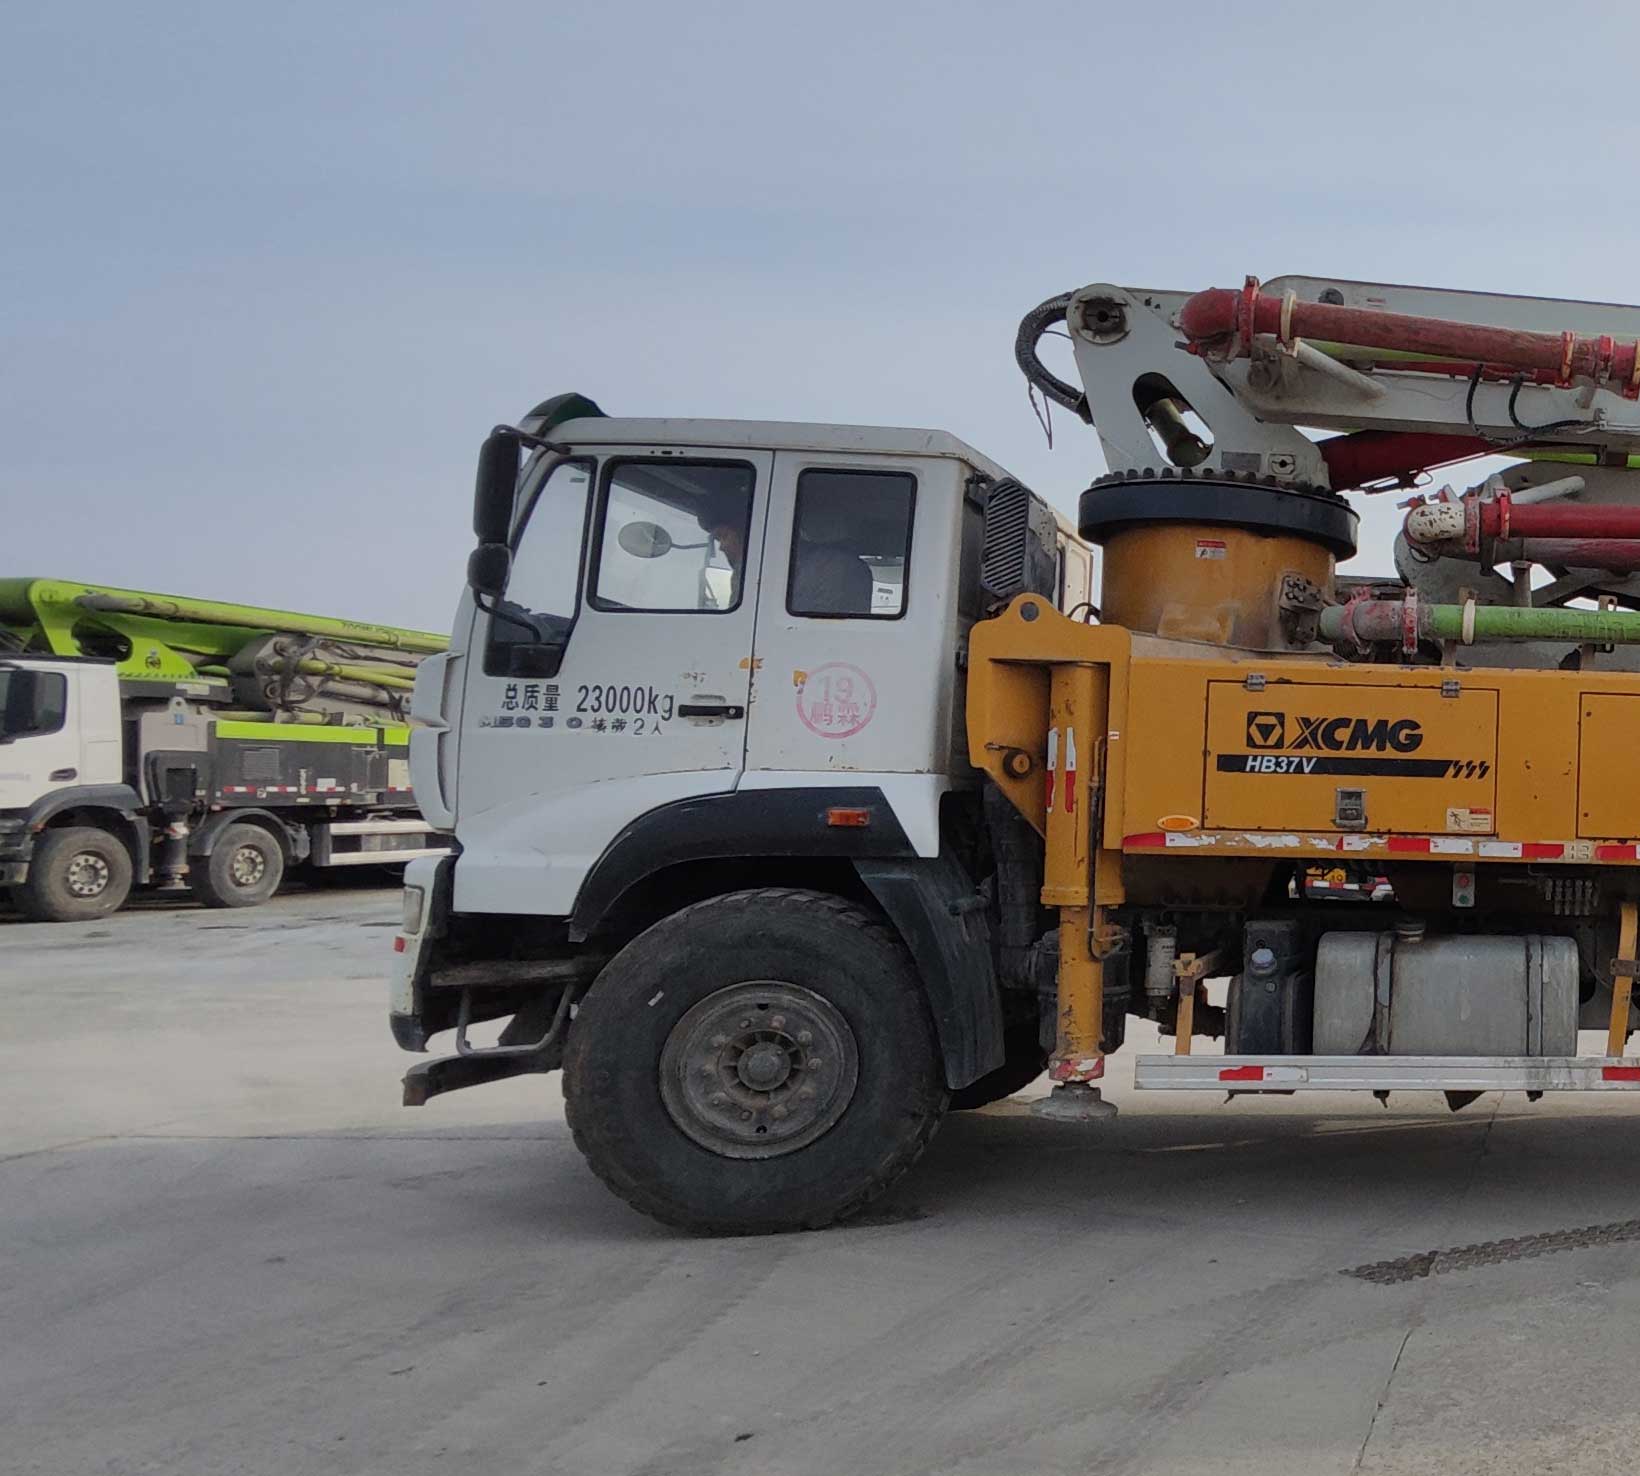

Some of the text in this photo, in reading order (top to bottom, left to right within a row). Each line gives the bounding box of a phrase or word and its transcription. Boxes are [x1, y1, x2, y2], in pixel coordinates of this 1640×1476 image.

[502, 684, 674, 721] 总质量 23000kg
[1286, 717, 1424, 752] XCMG
[1245, 755, 1318, 774] HB37V
